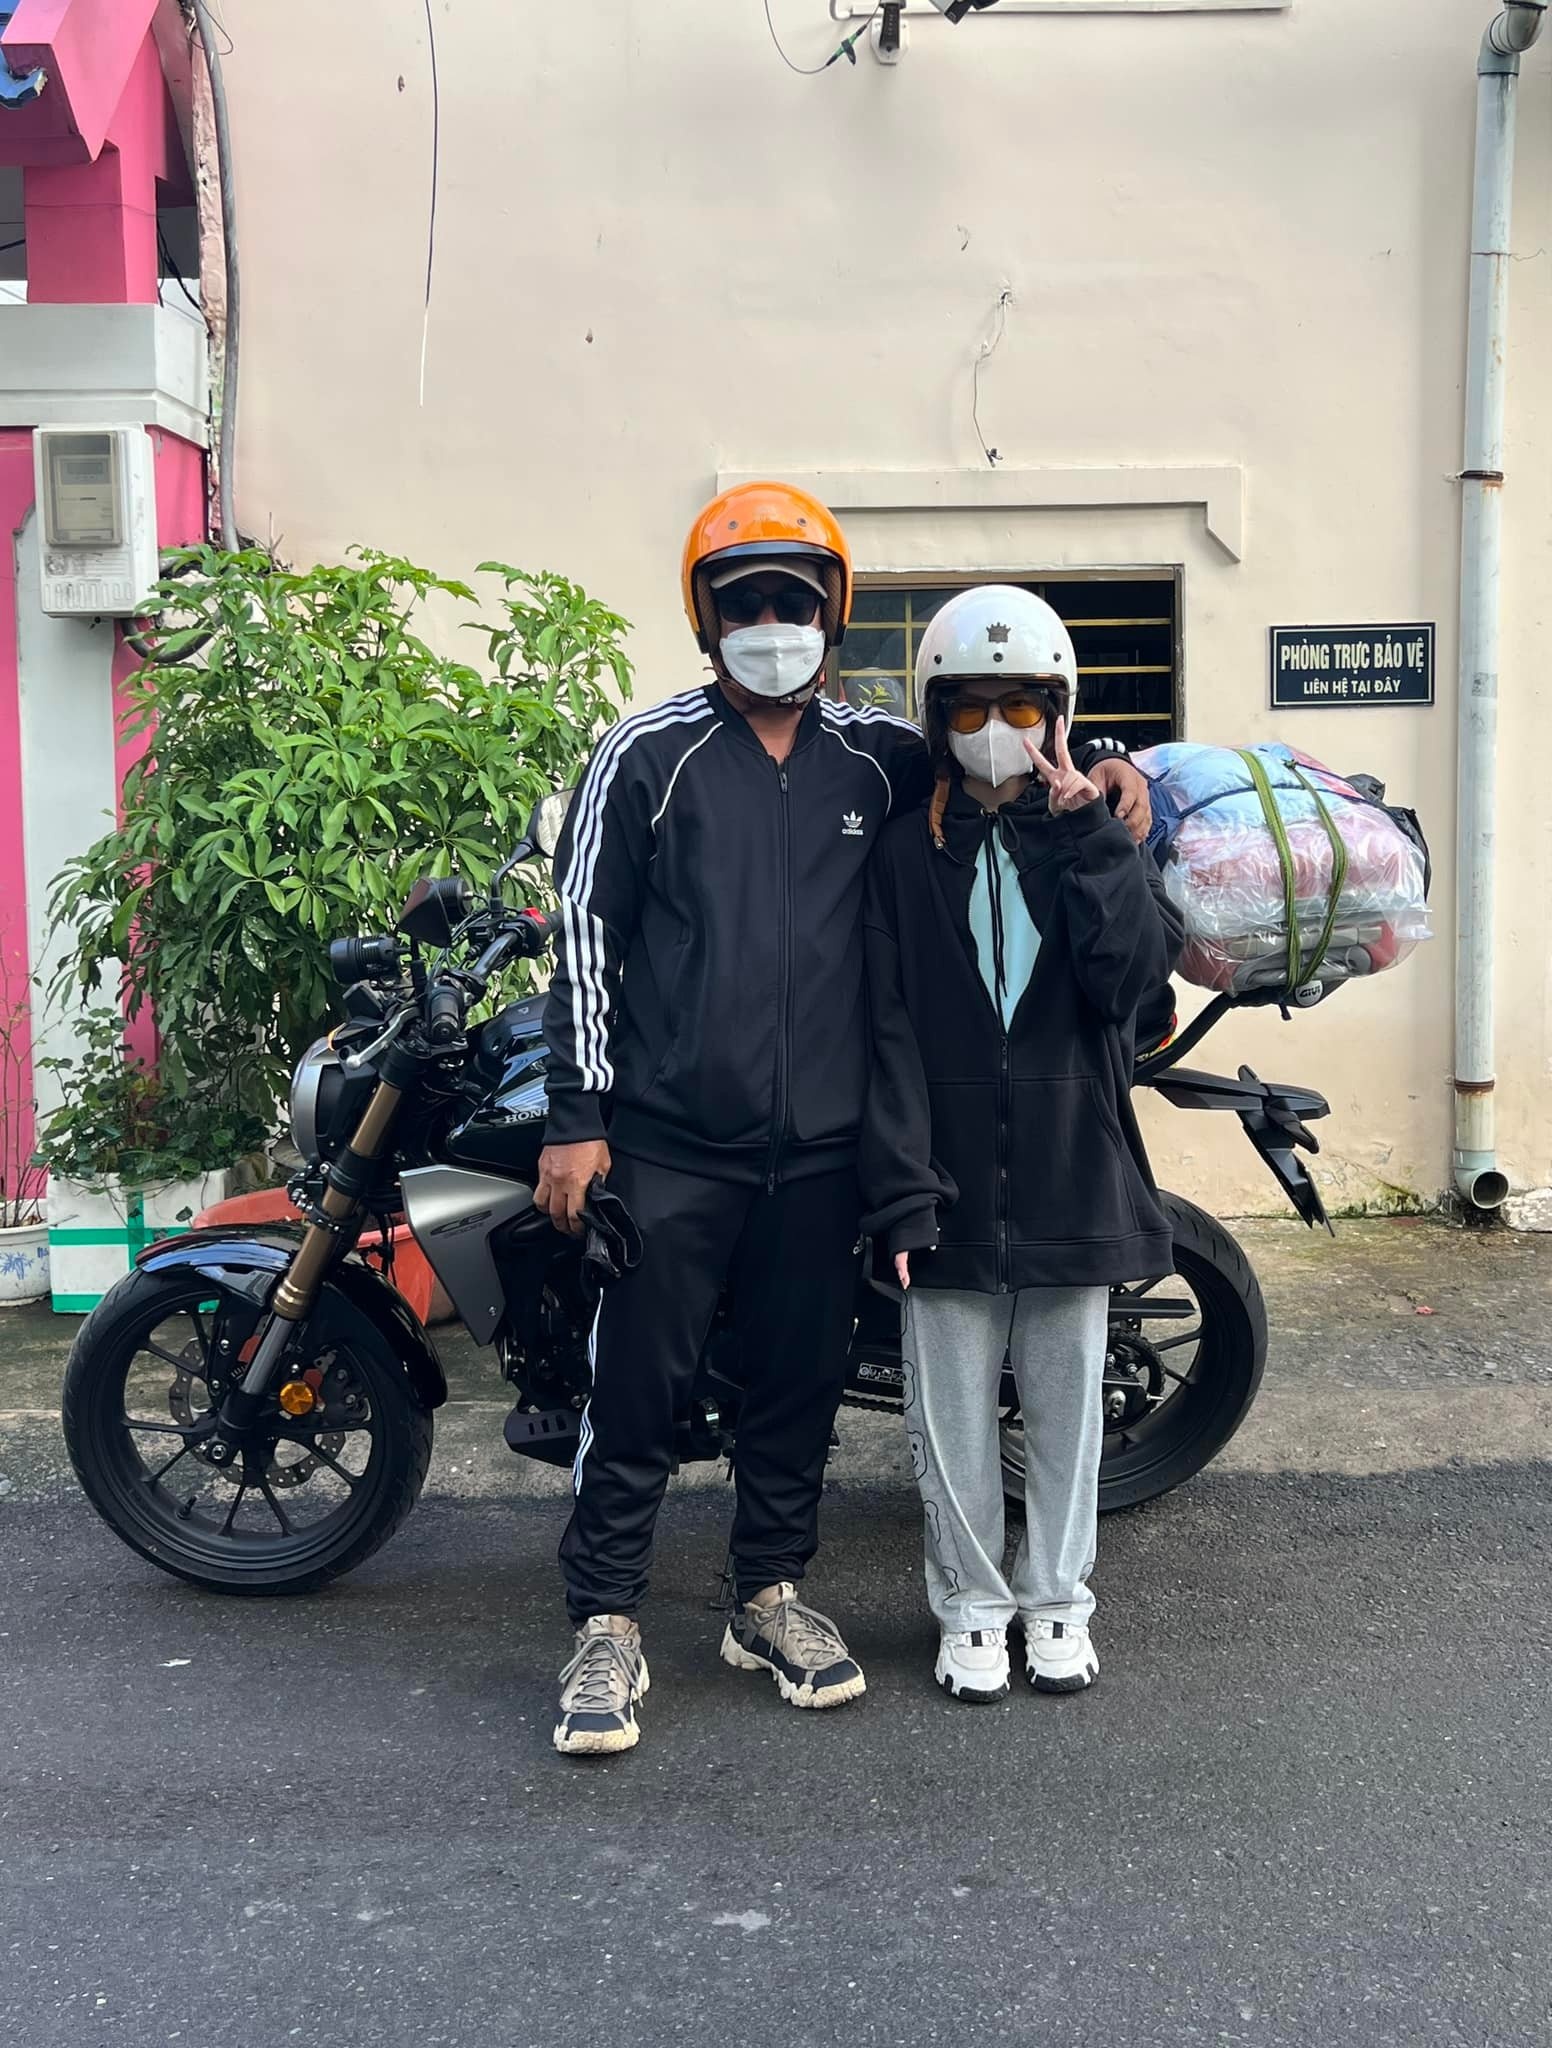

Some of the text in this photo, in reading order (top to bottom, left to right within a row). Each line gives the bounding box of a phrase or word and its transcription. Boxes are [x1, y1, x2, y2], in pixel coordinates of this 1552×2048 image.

[1281, 634, 1424, 674] PHÒNG TRỰC BẢO VỆ
[1304, 676, 1401, 697] LIÊN HỆ TẠI ĐÂY
